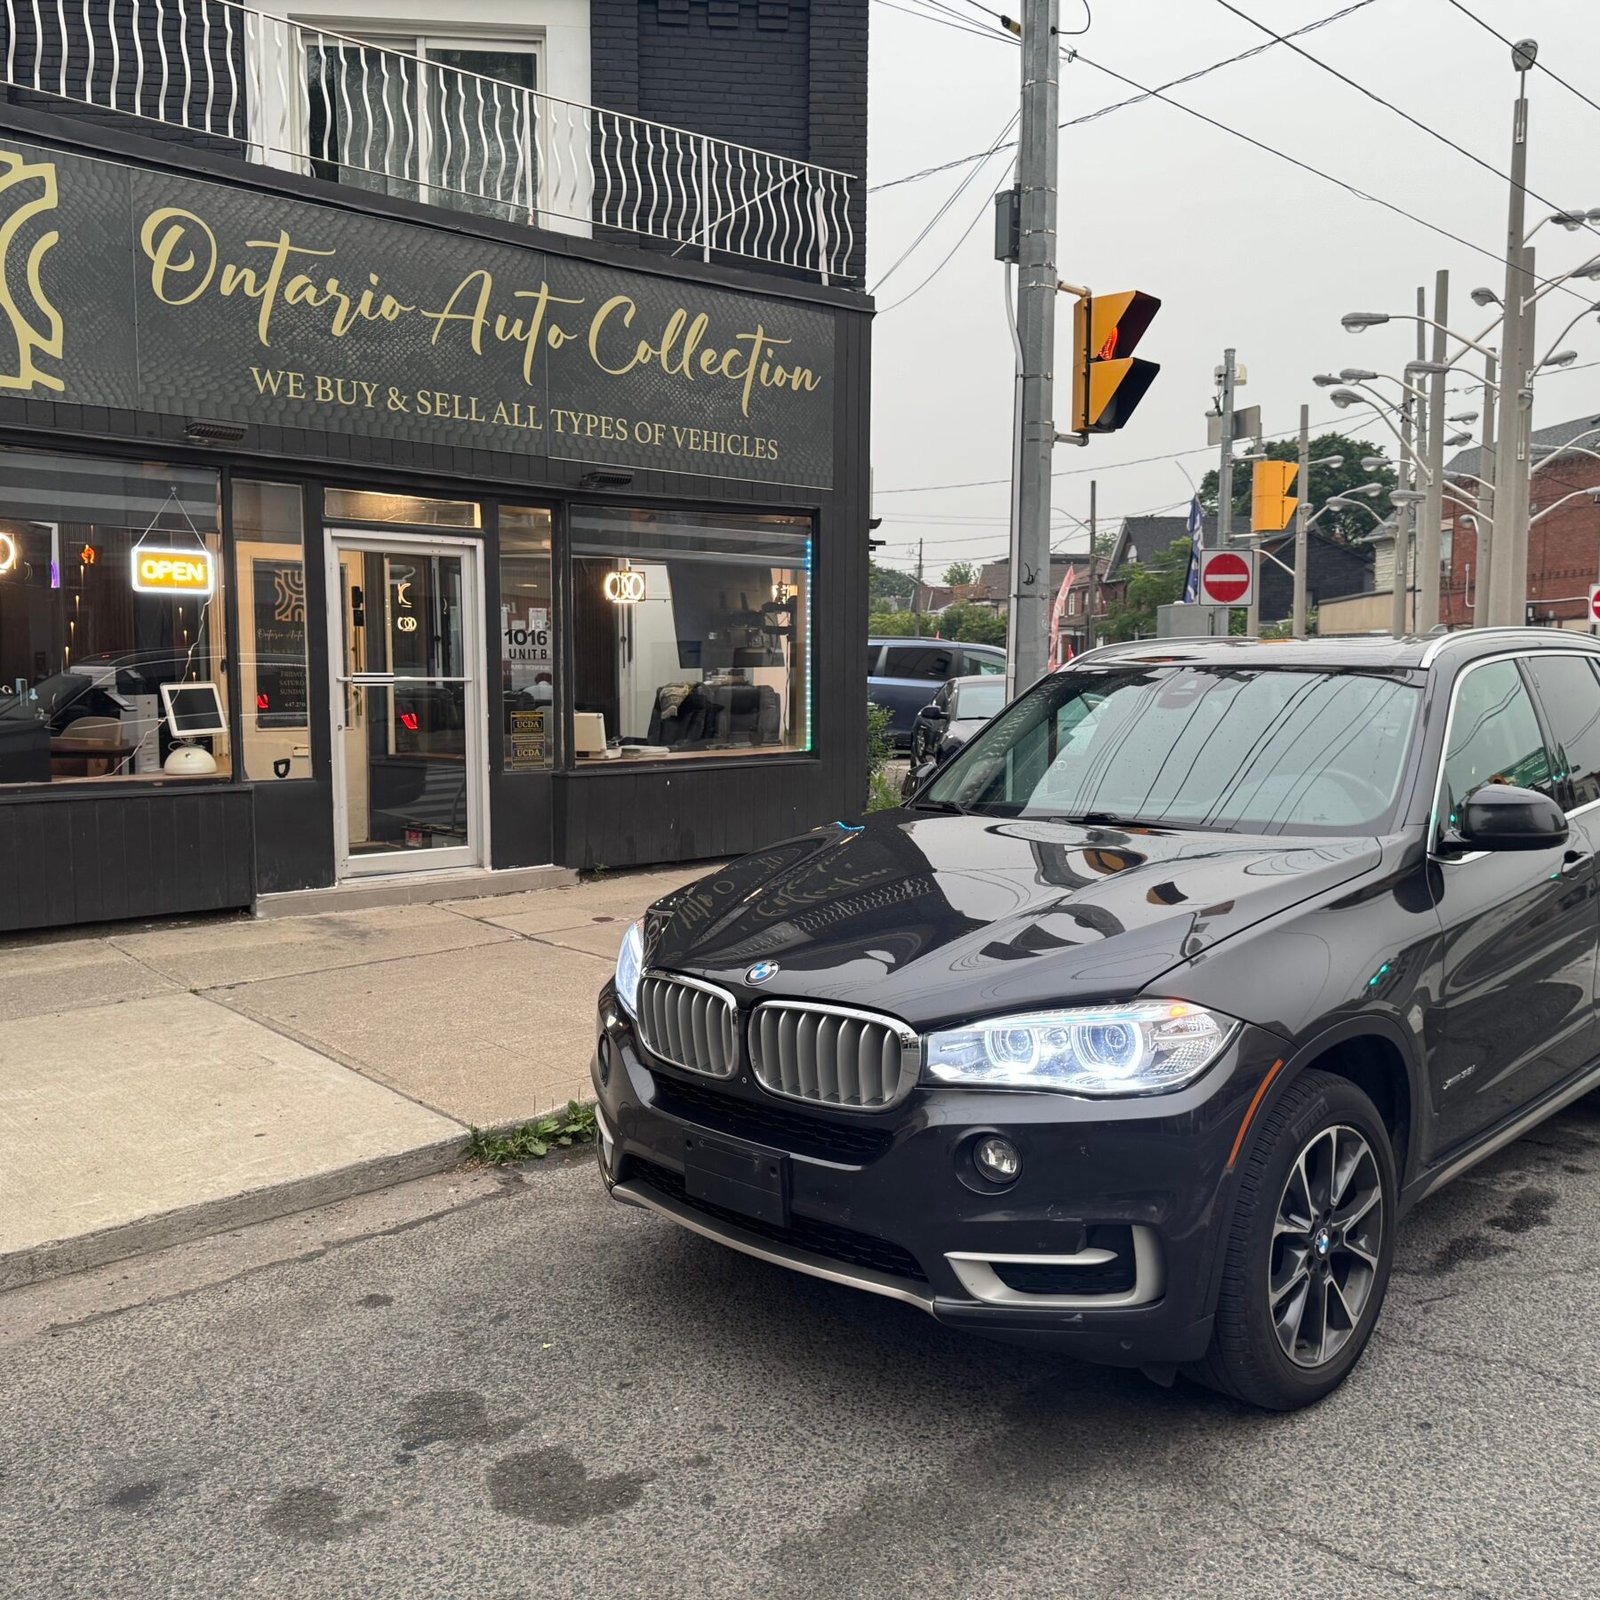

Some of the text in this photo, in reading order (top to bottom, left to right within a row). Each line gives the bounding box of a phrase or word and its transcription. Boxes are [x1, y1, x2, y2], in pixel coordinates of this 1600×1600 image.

[141, 208, 822, 418] Ontario Auto Collection
[249, 366, 779, 461] WE BUY & SELL ALL TYPES OF VEHICLES
[141, 559, 203, 582] OPEN
[504, 629, 548, 646] 1016
[508, 648, 548, 660] UNIT B
[516, 721, 540, 729] UCDA
[516, 749, 541, 757] UCDA
